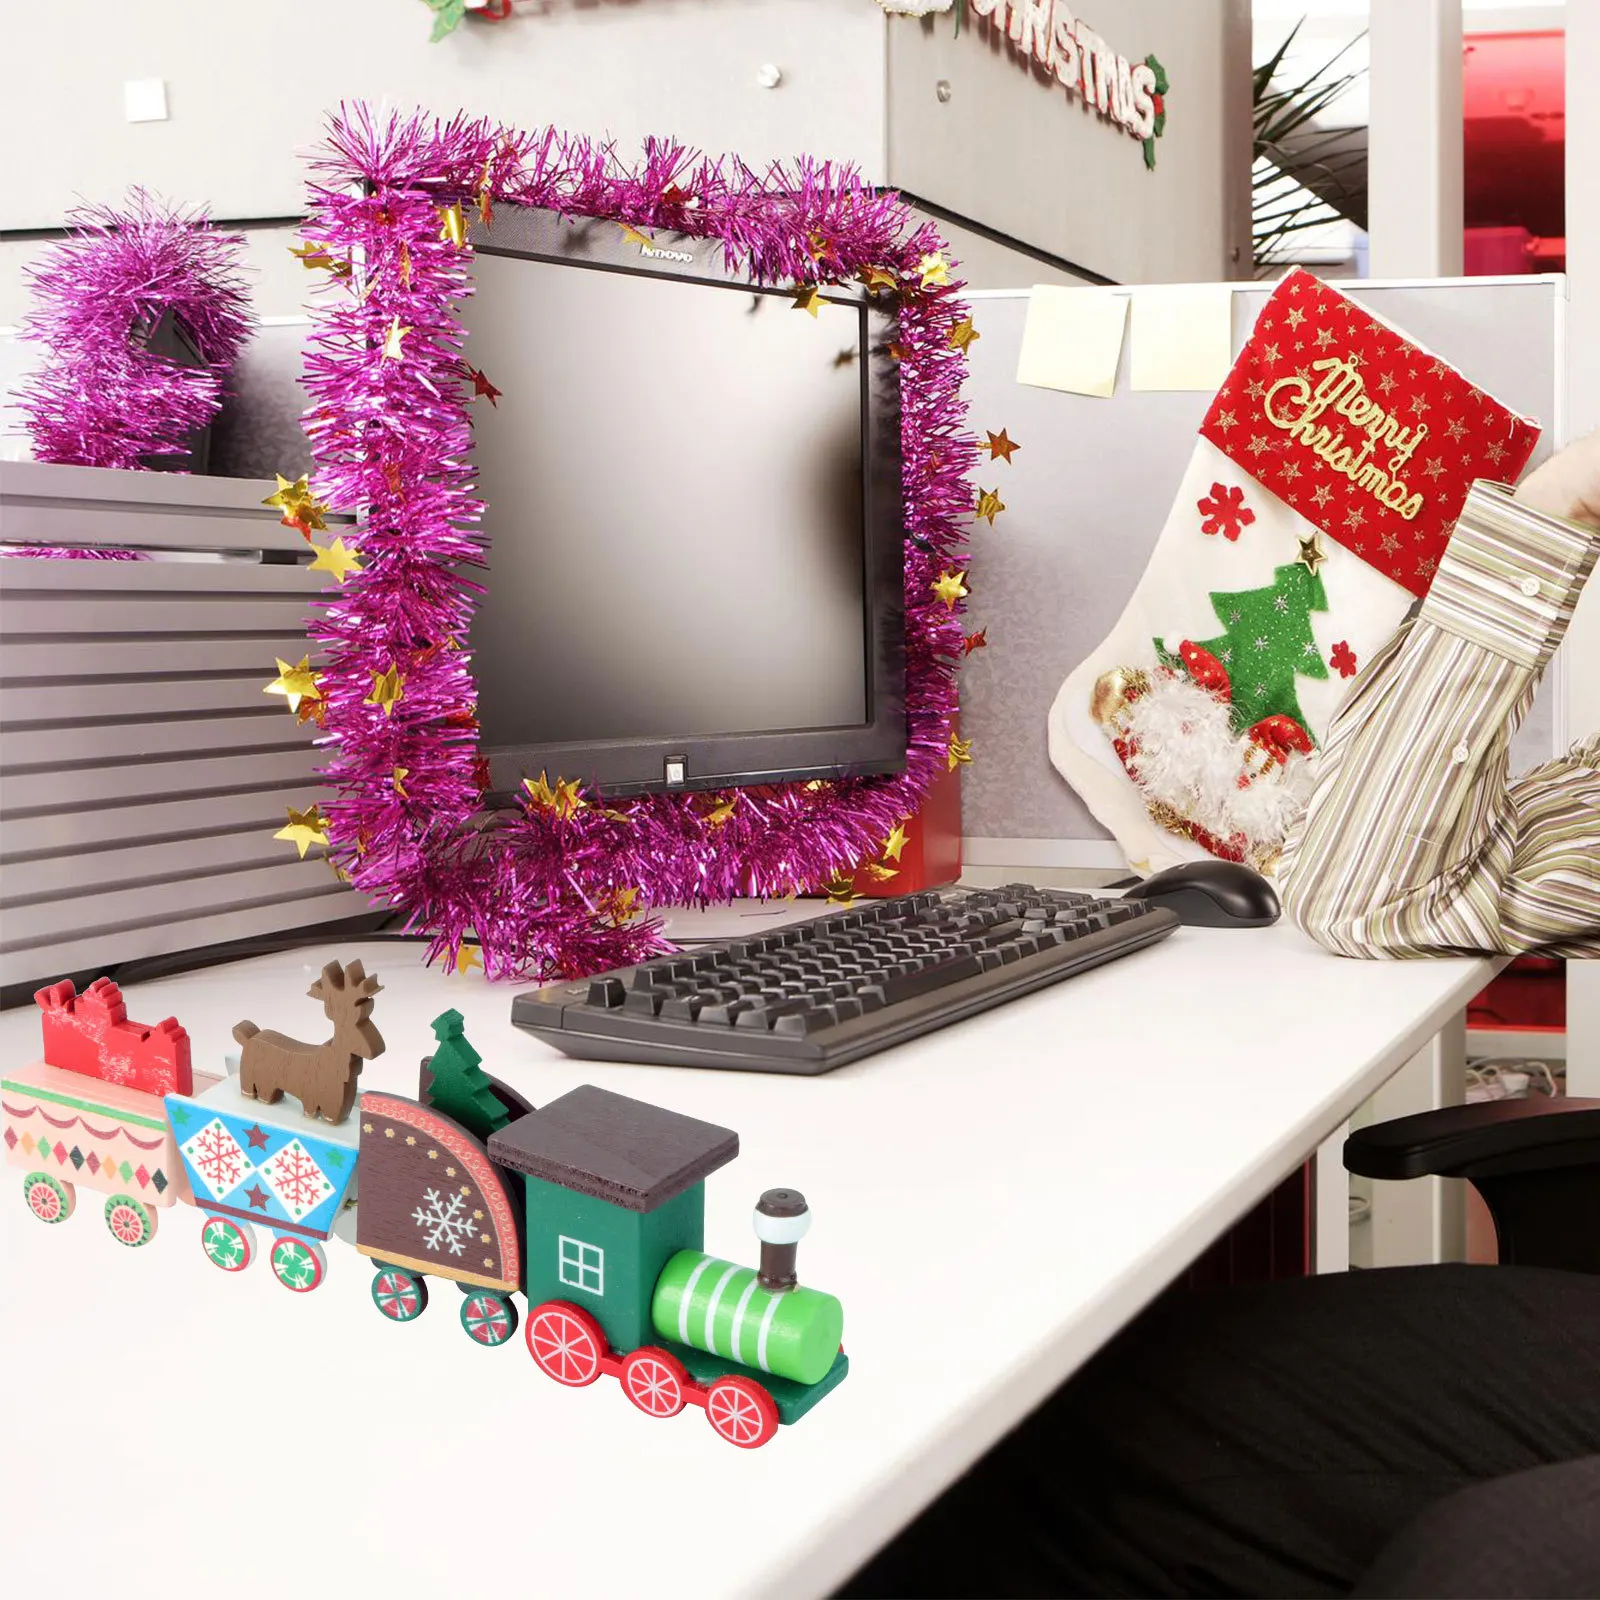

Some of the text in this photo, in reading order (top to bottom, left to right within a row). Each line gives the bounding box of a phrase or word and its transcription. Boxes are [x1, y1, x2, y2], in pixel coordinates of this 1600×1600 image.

[971, 0, 1157, 140] RISTMAS
[1264, 376, 1425, 520] Christmas
[1313, 356, 1427, 471] Merry
